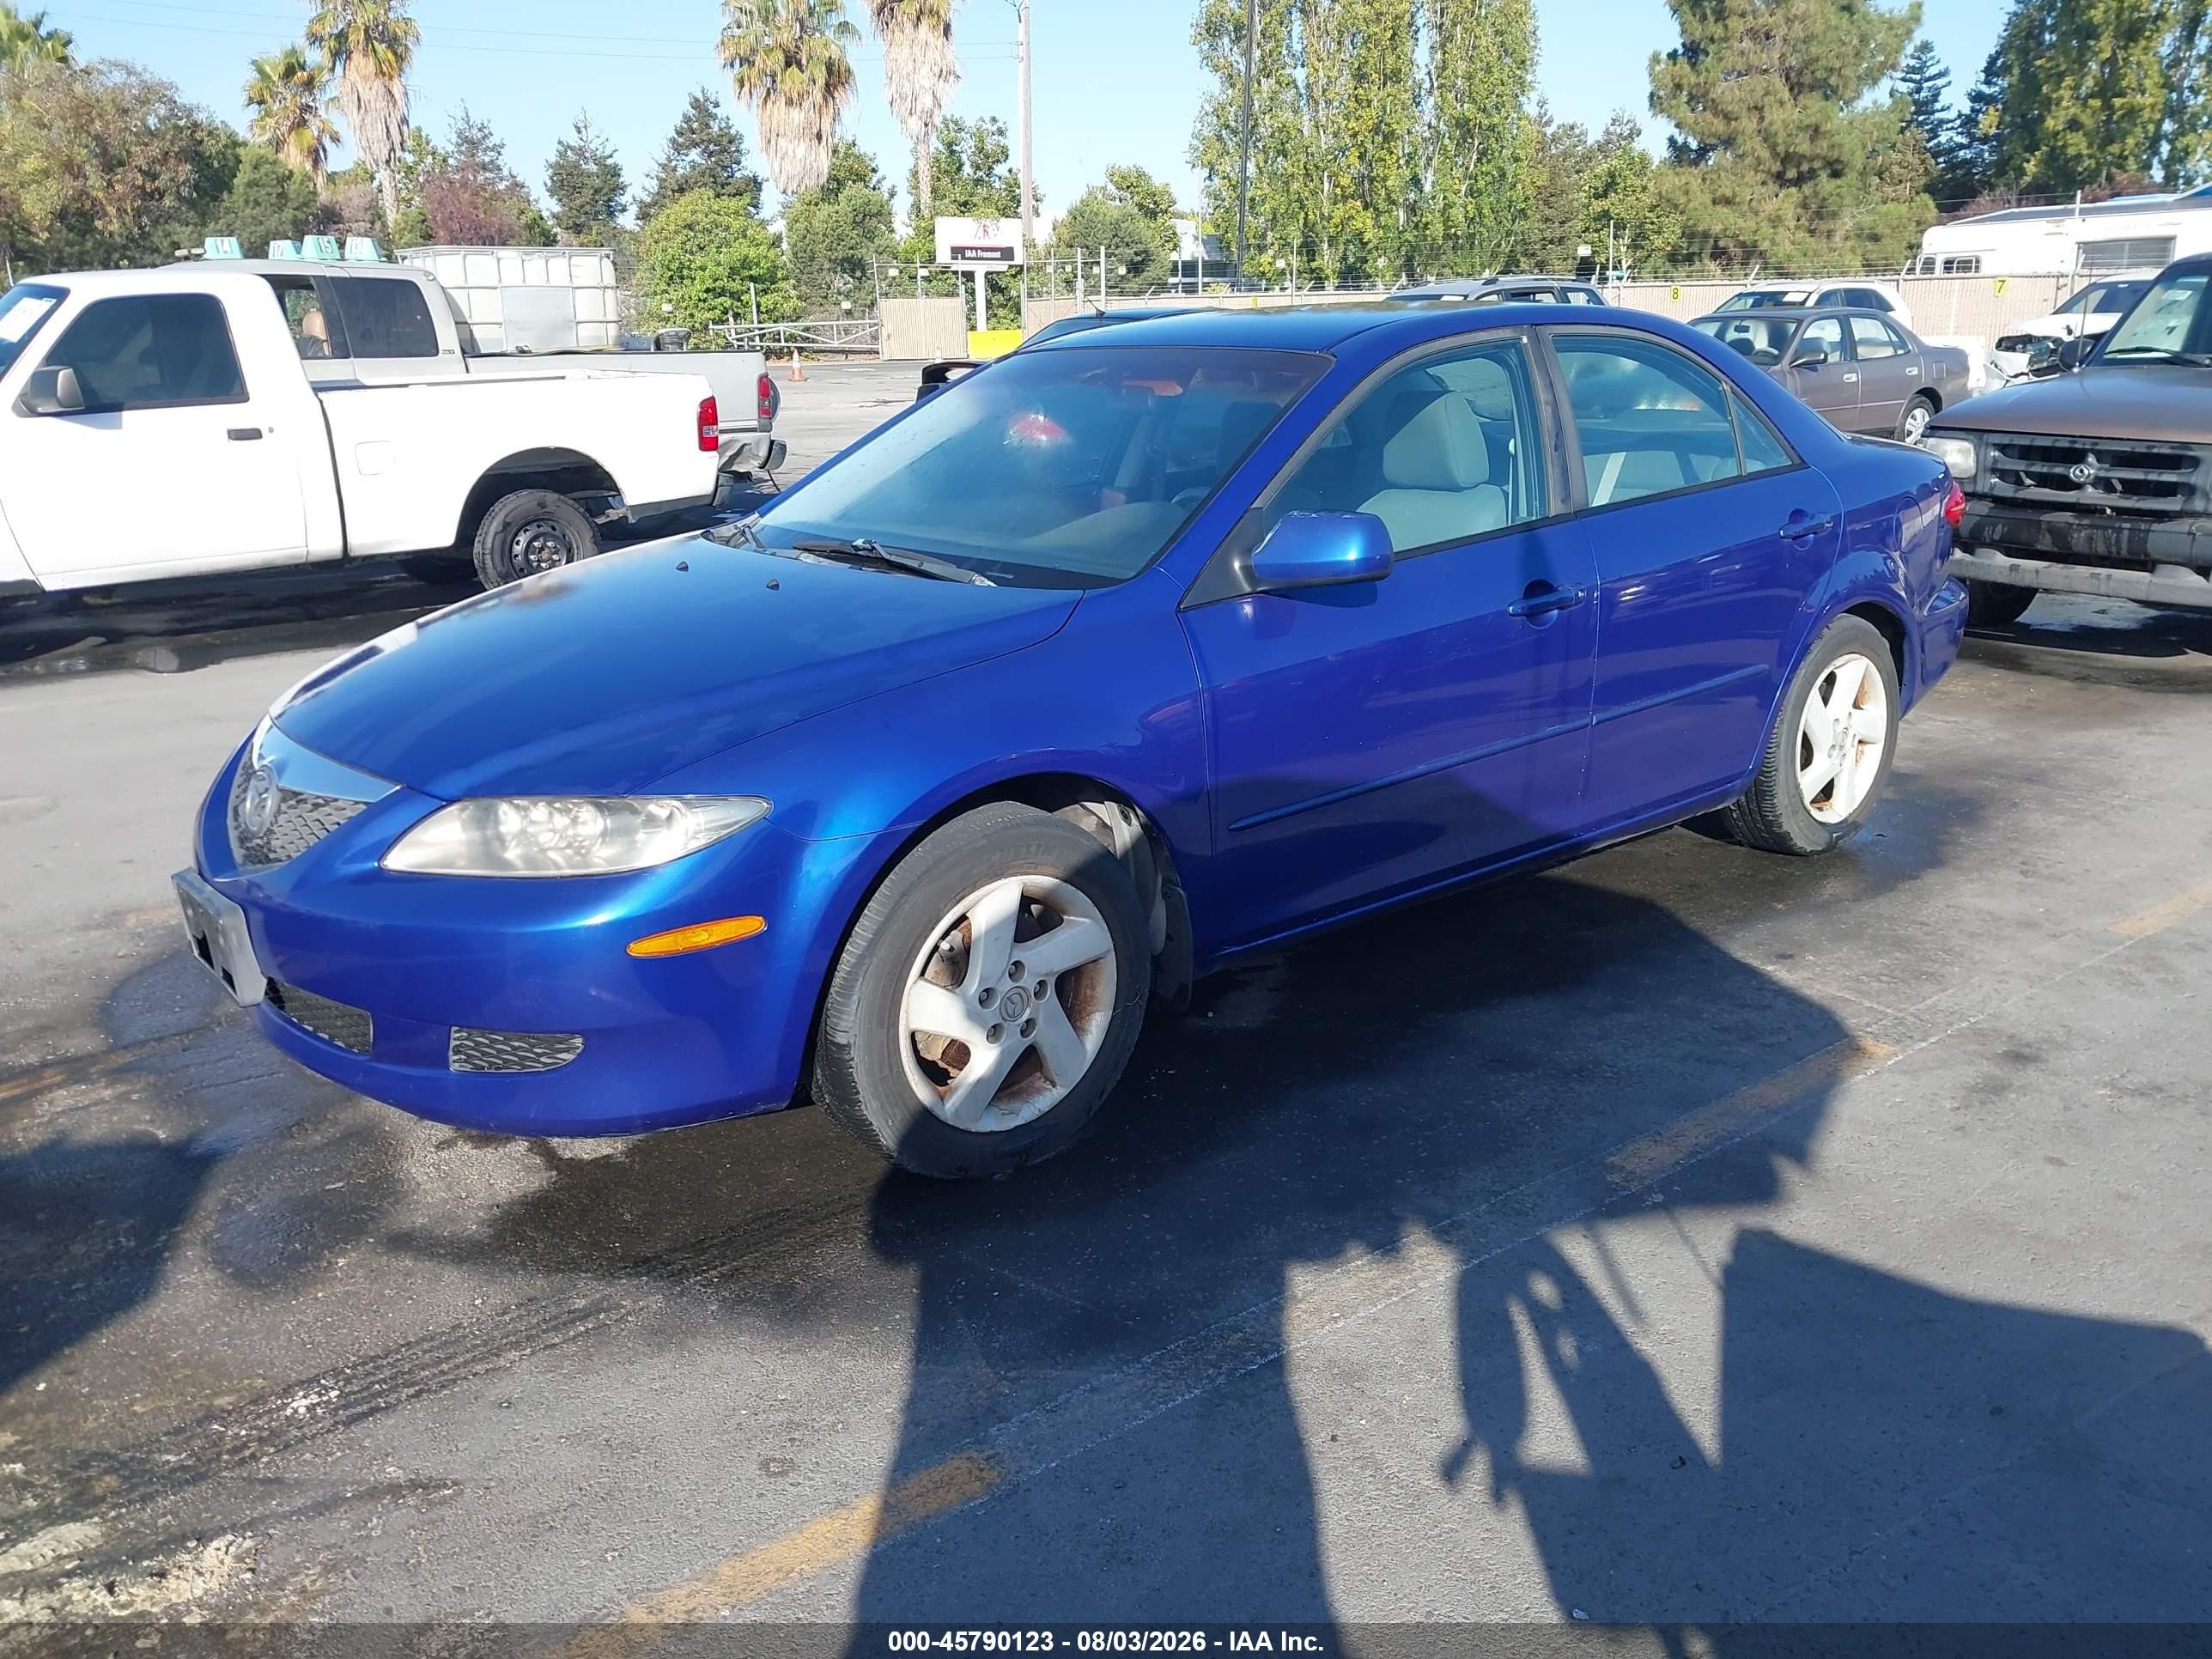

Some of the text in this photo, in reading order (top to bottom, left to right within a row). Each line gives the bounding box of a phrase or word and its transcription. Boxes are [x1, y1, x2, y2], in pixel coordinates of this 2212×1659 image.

[964, 249, 977, 258] IAA
[1997, 279, 2006, 294] 7
[1672, 287, 1679, 300] 8
